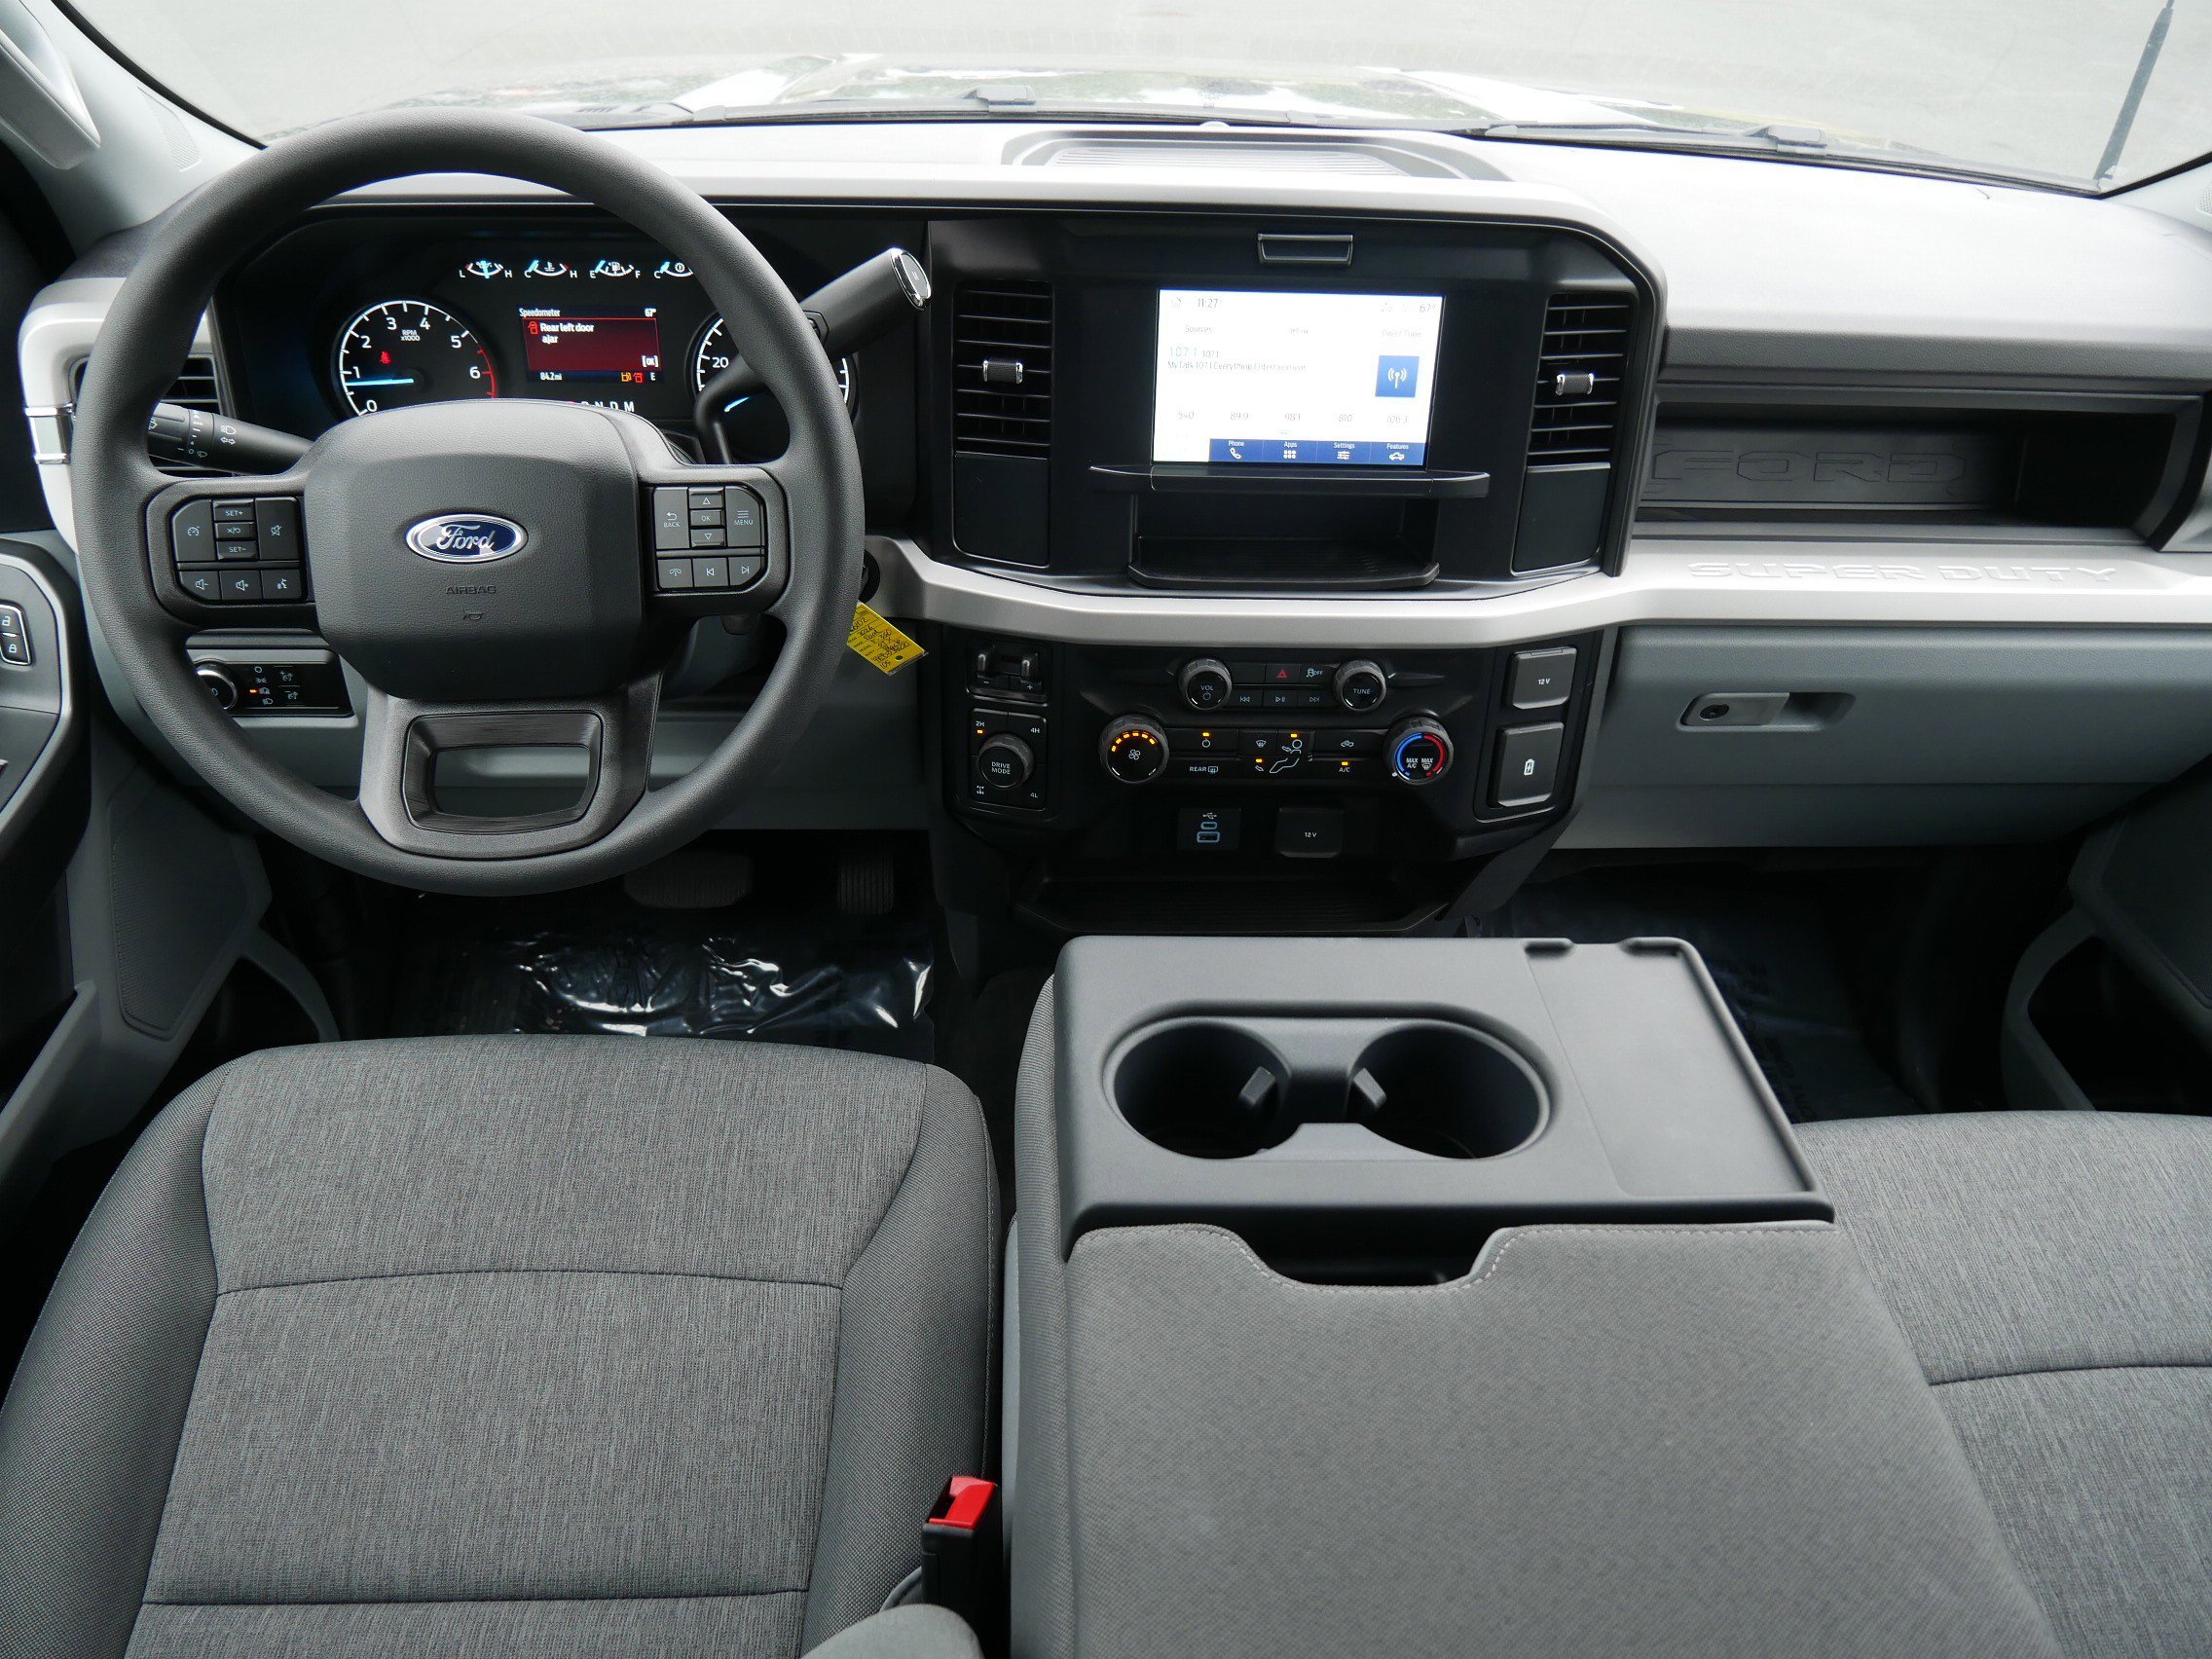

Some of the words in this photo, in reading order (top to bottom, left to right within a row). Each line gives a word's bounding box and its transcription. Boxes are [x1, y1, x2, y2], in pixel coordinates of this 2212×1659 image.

[505, 270, 513, 278] H
[524, 270, 531, 278] C
[570, 270, 578, 278] H
[590, 271, 596, 279] E
[635, 271, 641, 279] F
[654, 271, 661, 279] C
[1198, 298, 1218, 308] 11:27
[519, 308, 561, 317] Speedometer
[386, 316, 397, 330] 3
[420, 317, 431, 330] 4
[540, 322, 559, 332] Rear
[560, 322, 575, 332] left
[575, 322, 594, 332] door
[361, 335, 372, 348] 2
[451, 335, 462, 348] 5
[542, 334, 558, 344] ajar
[712, 357, 729, 369] 20
[353, 366, 360, 378] 1
[470, 366, 481, 379] 6
[366, 399, 377, 412] 0
[624, 401, 634, 412] M
[1283, 441, 1298, 450] Apps
[1333, 442, 1355, 450] Settings
[436, 524, 495, 550] Ford
[1688, 562, 1925, 580] SUPER
[1937, 565, 2118, 583] DUTY
[446, 586, 497, 595] AIRBAG
